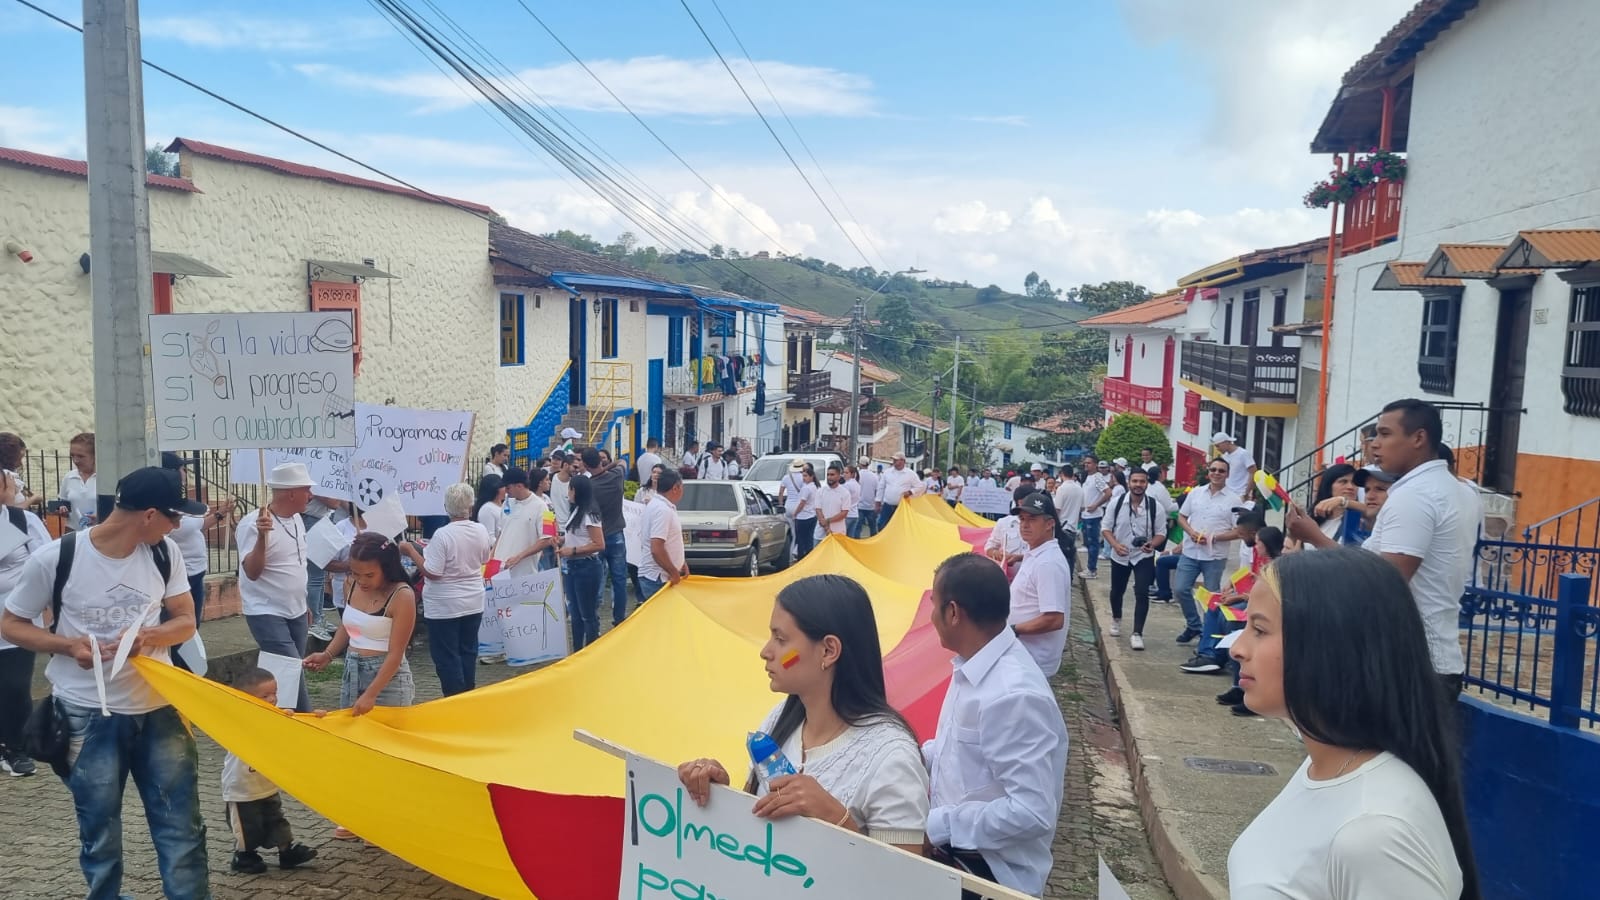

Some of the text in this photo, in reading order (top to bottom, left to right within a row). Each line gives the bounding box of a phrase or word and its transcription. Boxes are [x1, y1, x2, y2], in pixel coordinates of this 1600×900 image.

[211, 336, 226, 355] a
[237, 319, 257, 356] la
[269, 319, 312, 356] vida
[213, 359, 235, 400] al
[249, 371, 338, 410] progreso
[213, 415, 228, 441] a
[367, 414, 468, 453] Programas de
